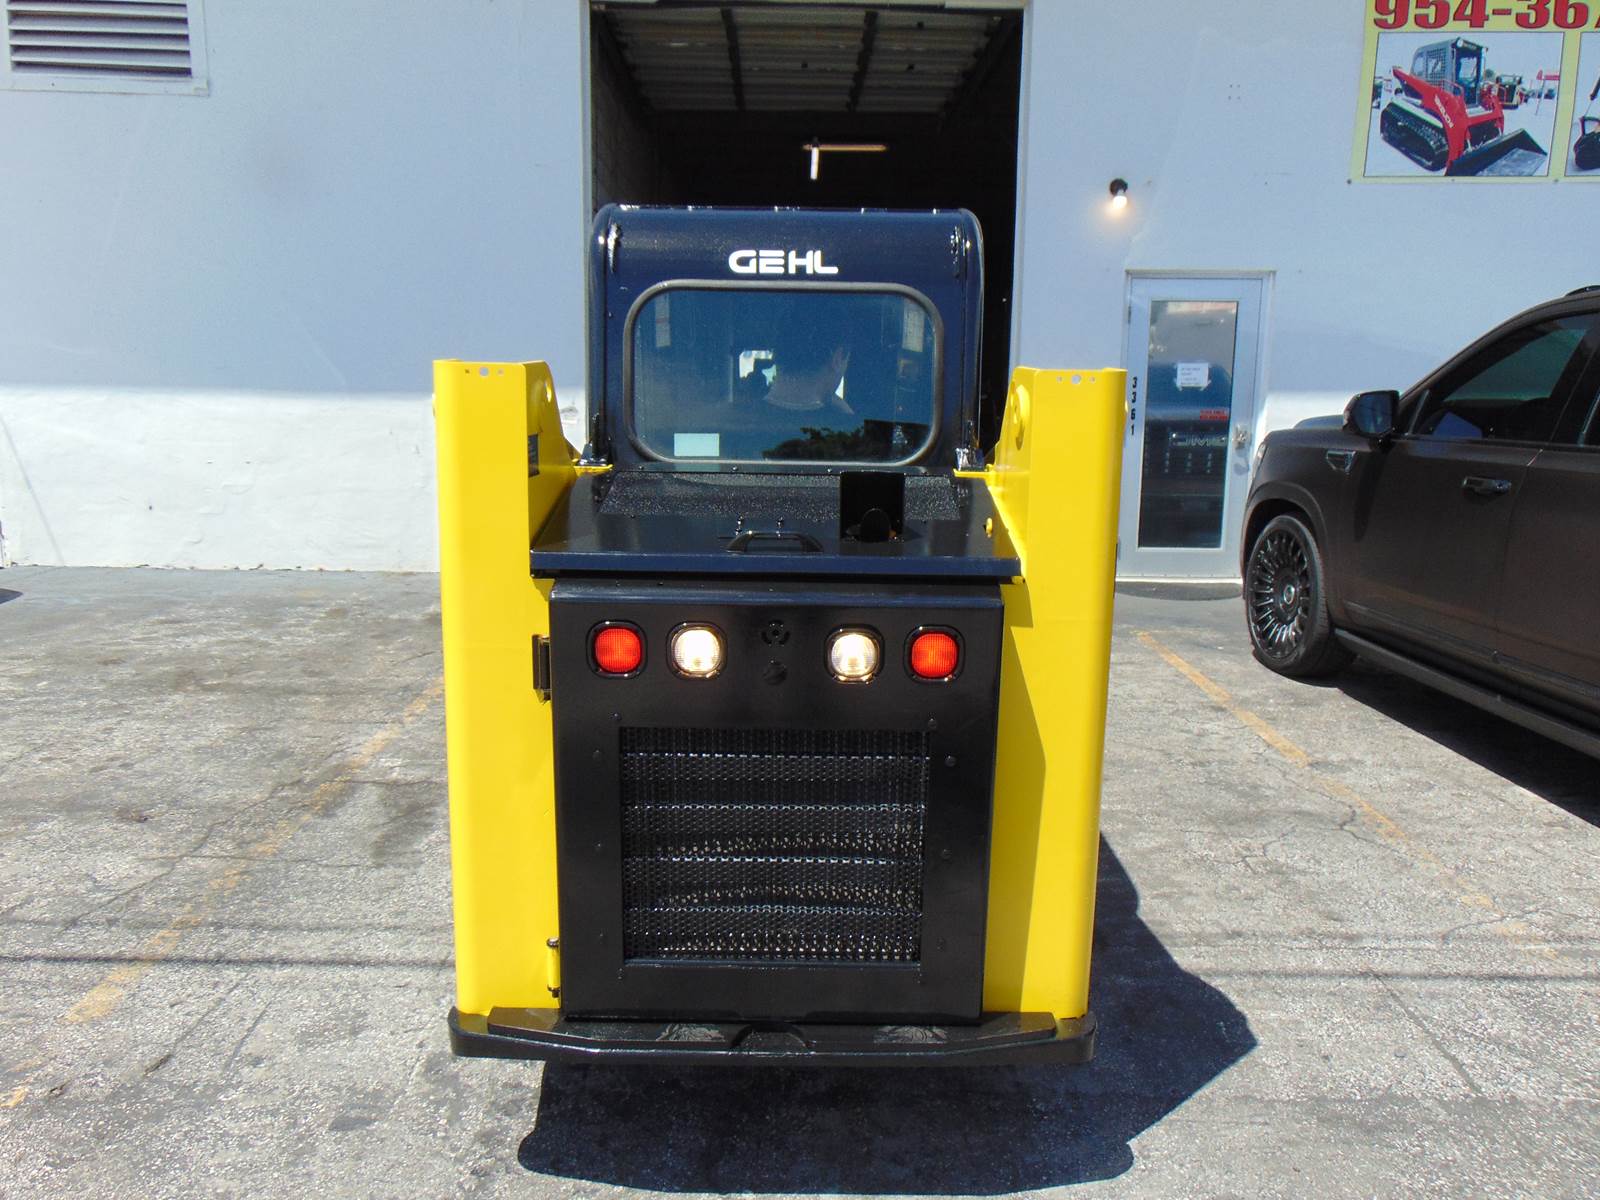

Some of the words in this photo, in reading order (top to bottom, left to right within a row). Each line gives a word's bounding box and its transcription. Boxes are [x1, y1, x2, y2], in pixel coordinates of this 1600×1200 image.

[1373, 0, 1600, 29] 954-36
[728, 249, 839, 274] GEHL
[1130, 376, 1138, 436] 3361
